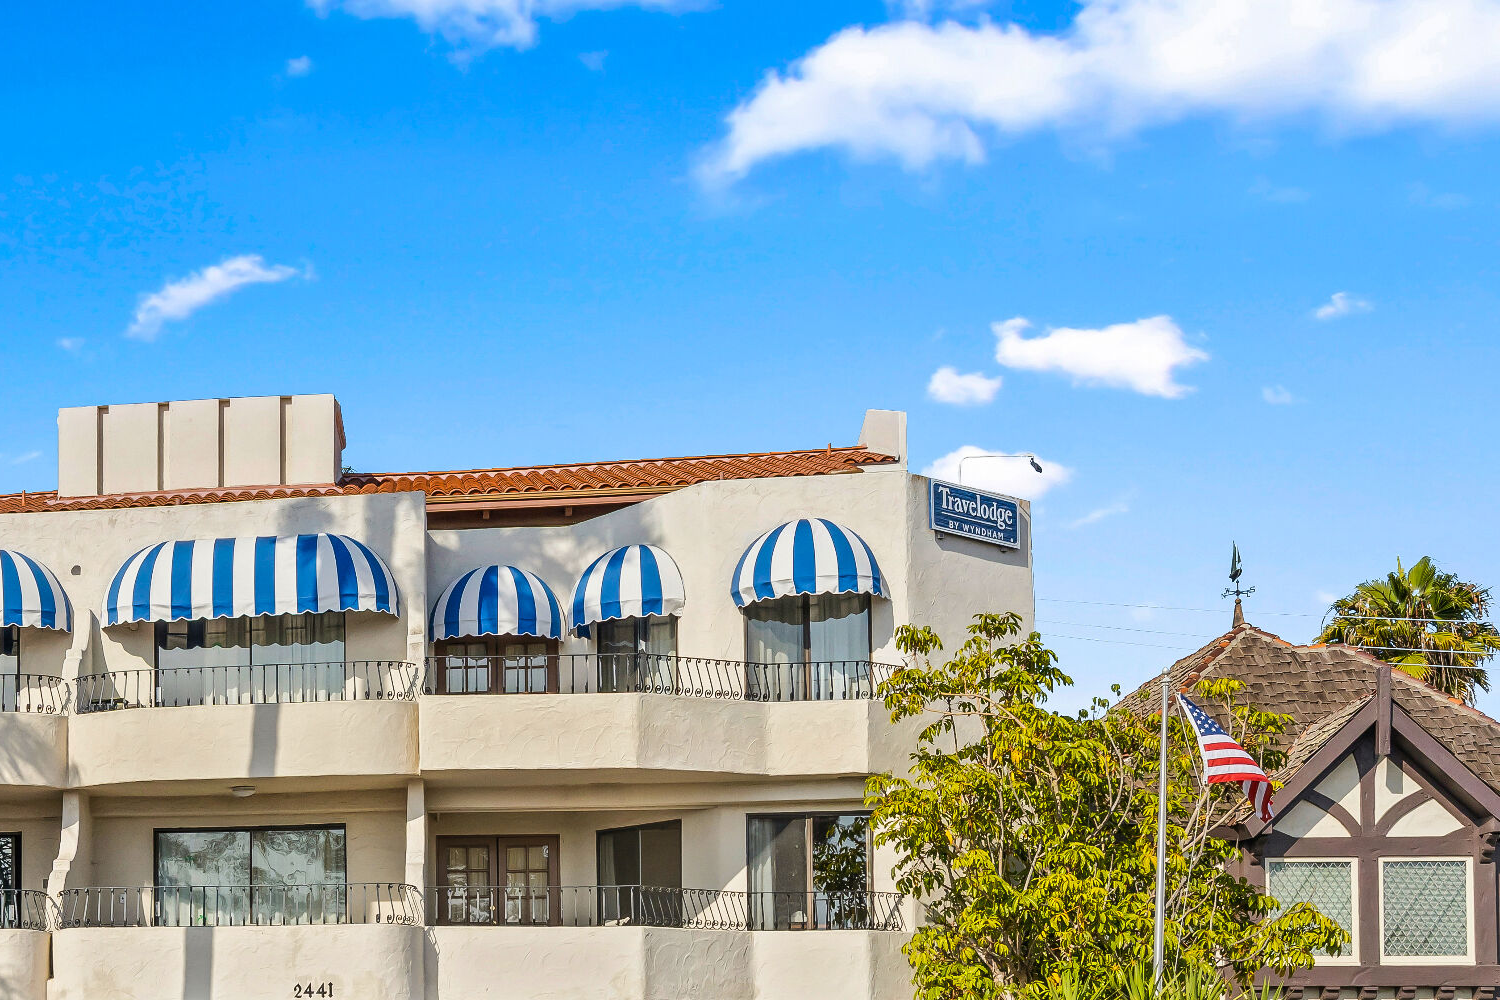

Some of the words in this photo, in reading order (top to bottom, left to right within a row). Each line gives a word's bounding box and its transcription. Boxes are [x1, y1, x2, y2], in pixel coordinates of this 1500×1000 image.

[938, 486, 1013, 530] Travelodge
[948, 520, 959, 530] BY
[962, 523, 1004, 541] WYNDHAM
[293, 982, 334, 999] 2441
